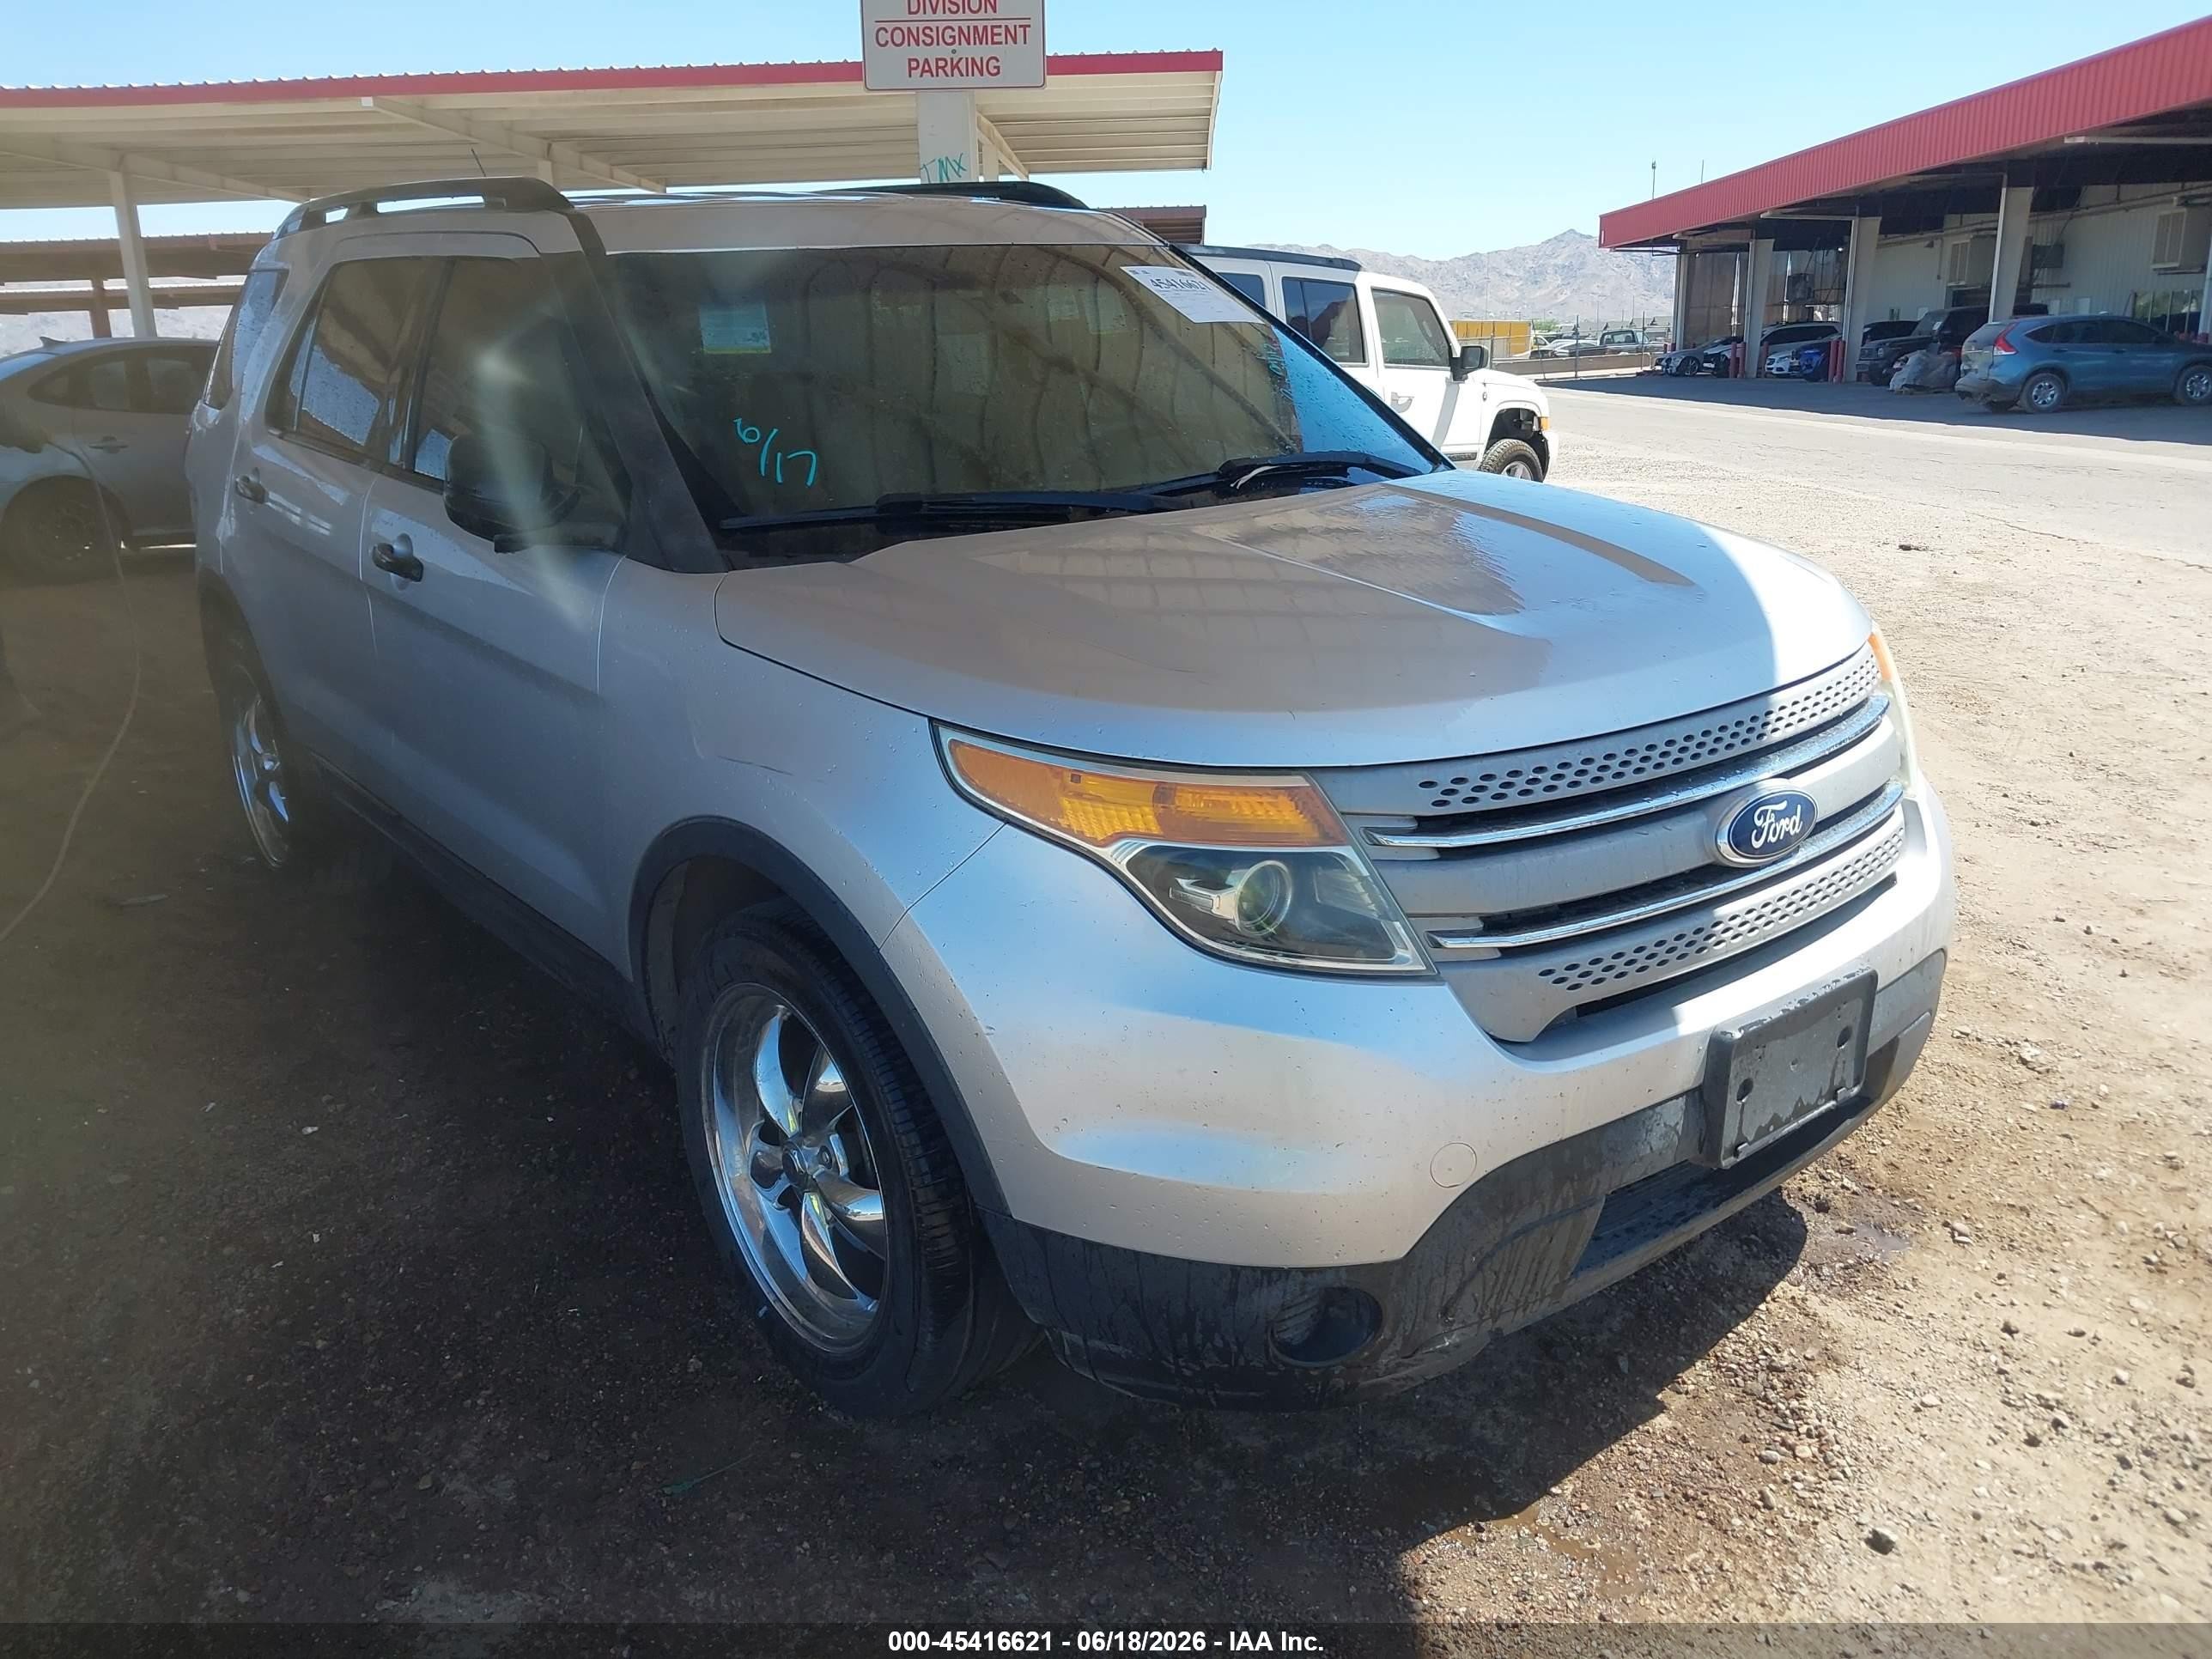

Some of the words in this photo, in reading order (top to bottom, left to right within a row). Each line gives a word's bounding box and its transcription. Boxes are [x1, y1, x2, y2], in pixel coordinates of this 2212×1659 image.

[907, 0, 997, 15] DIVISION
[875, 24, 1030, 47] CONSIGNMENT
[908, 56, 1001, 78] PARKING
[1150, 278, 1210, 290] 45416621
[733, 417, 817, 487] 6/17
[1752, 799, 1803, 848] Ford
